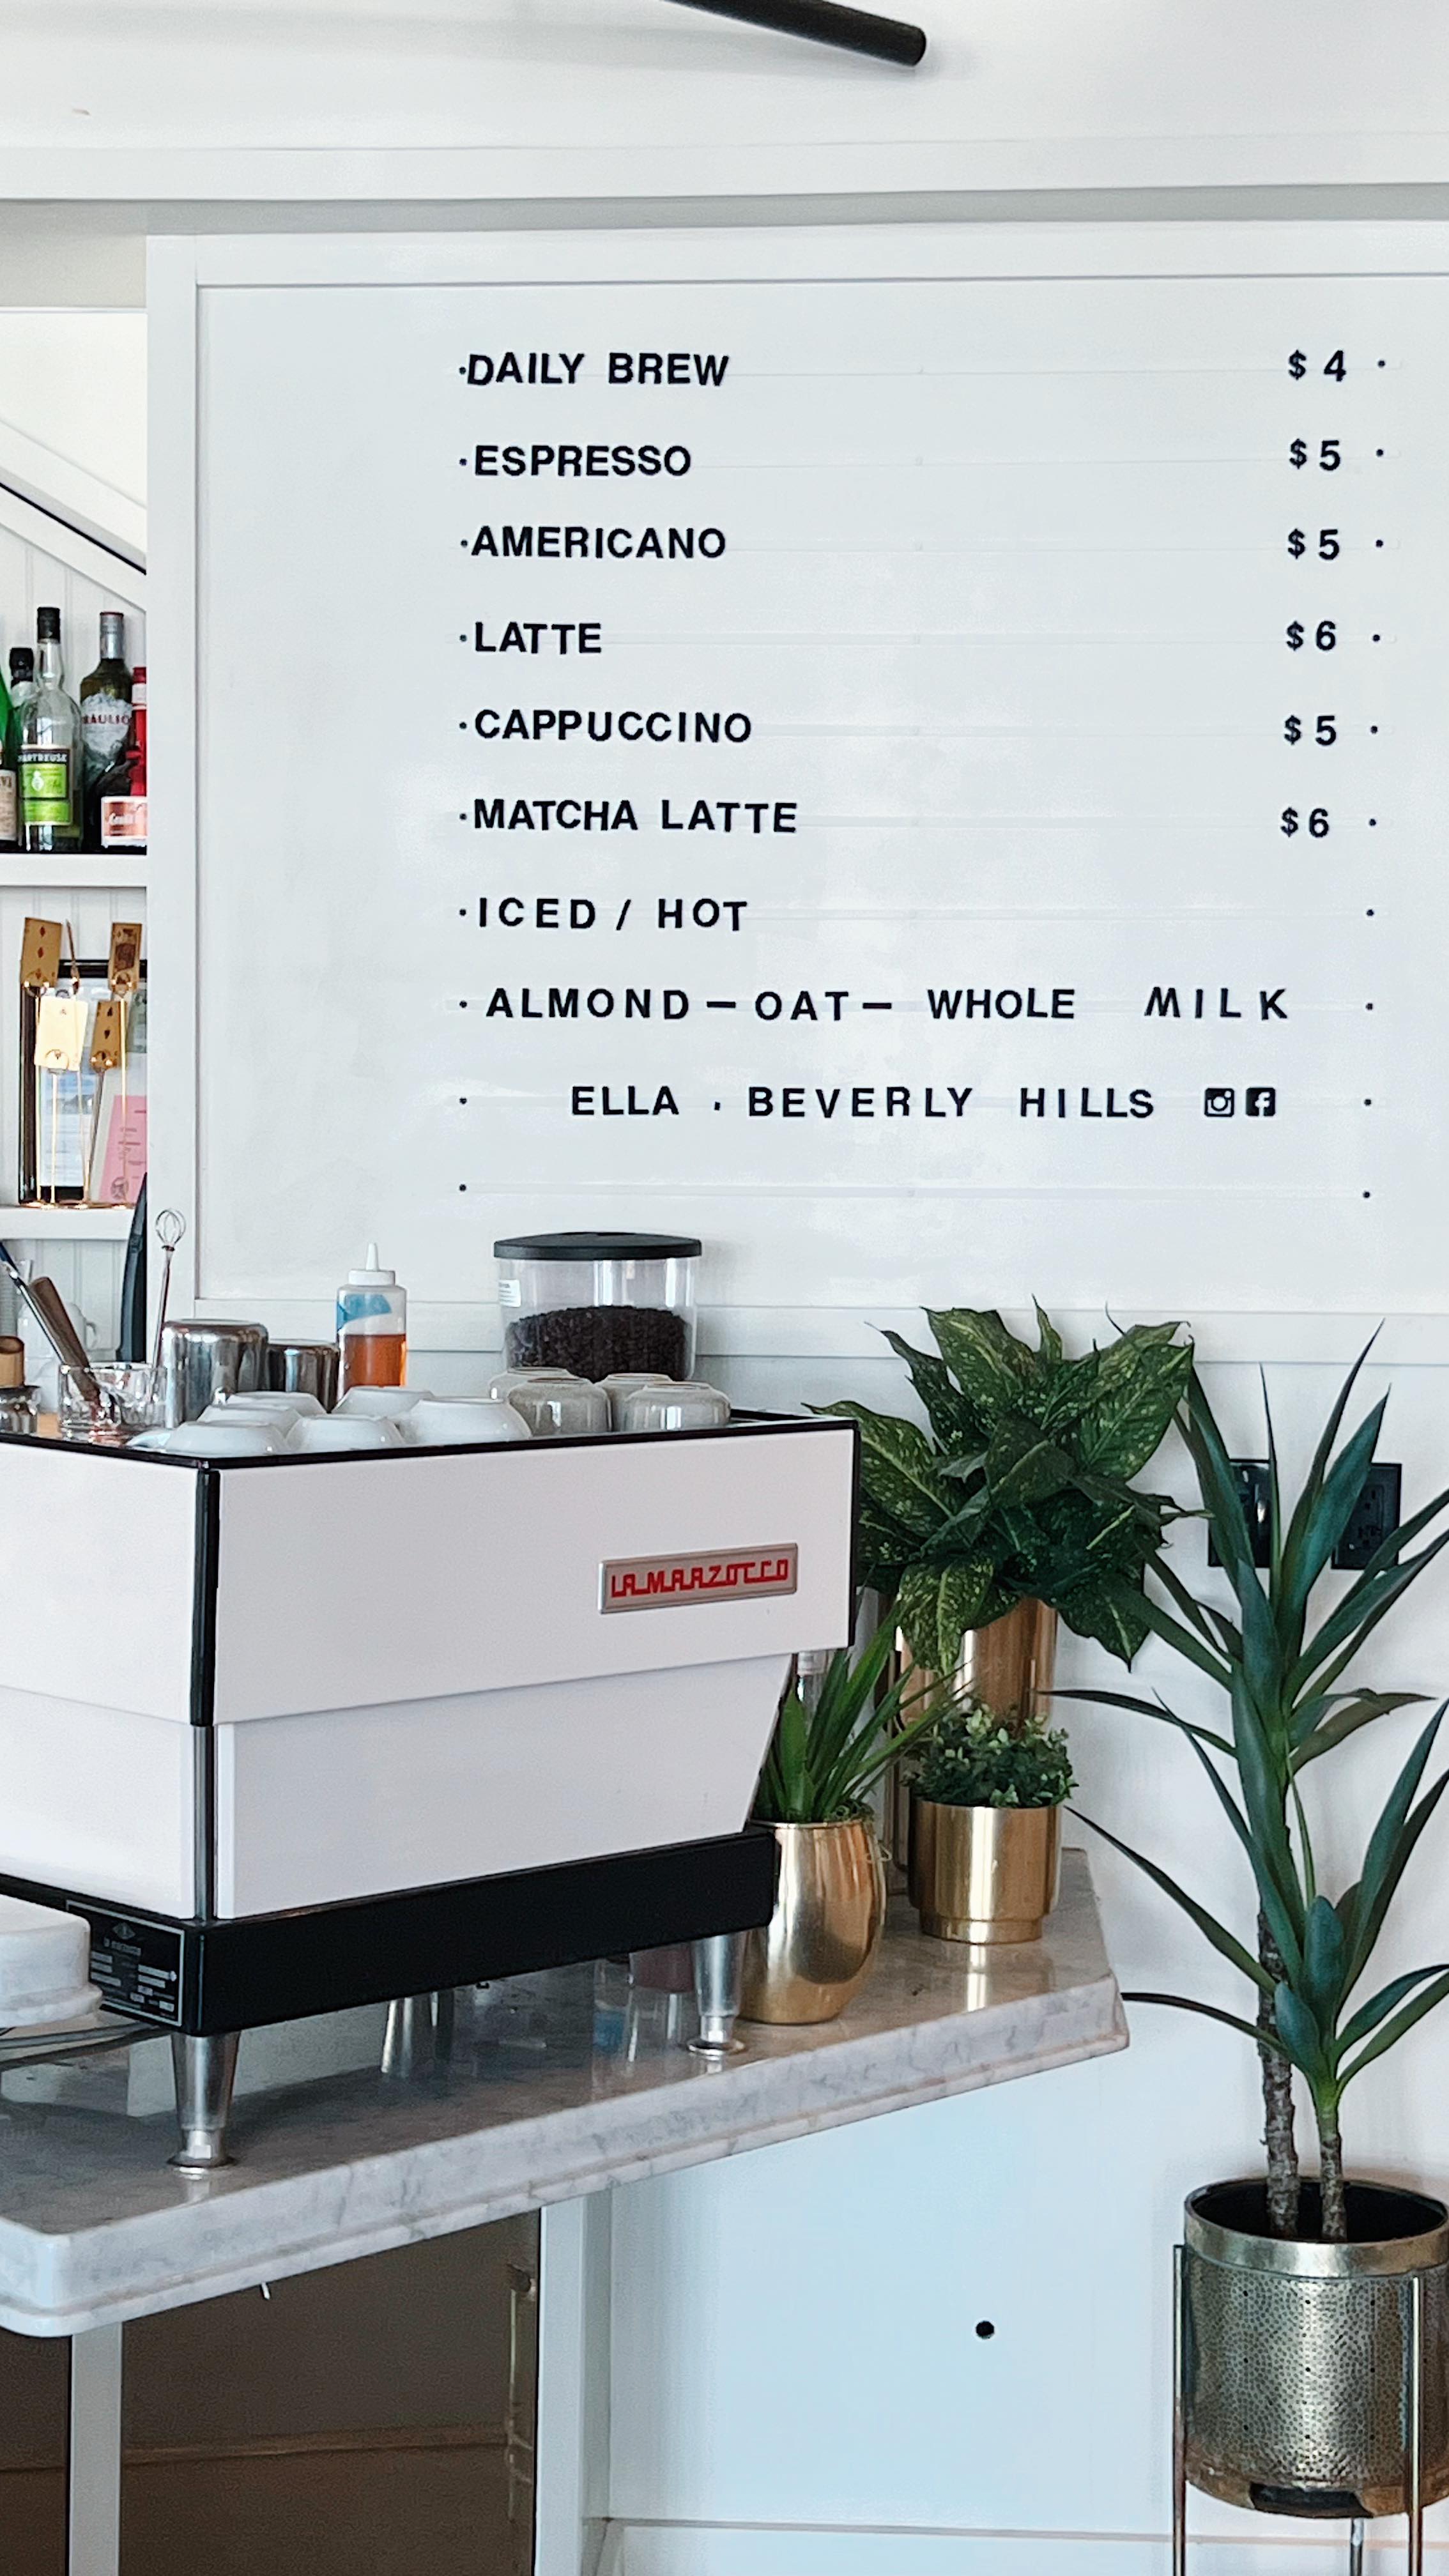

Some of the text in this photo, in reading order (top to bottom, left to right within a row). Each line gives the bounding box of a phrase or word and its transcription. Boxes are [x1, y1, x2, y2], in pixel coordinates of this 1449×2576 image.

[467, 351, 730, 387] DAILY BREW
[474, 444, 692, 477] ESPRESSO
[1289, 438, 1342, 472] $5
[470, 525, 726, 560] AMERICANO
[1287, 528, 1340, 561] $5
[474, 620, 602, 656] LATTE
[1285, 620, 1337, 652] $6
[82, 713, 130, 725] RAULIO
[474, 709, 752, 744] CAPPUCCINO
[1284, 714, 1337, 747] $5
[473, 798, 798, 834] MATCHA LATTE
[1280, 806, 1330, 839] $6
[479, 896, 596, 930] ICED
[657, 898, 748, 932] HOT
[485, 987, 689, 1020] ALMOND
[926, 987, 1076, 1020] WHOLE
[1144, 986, 1288, 1021] MILK
[571, 1085, 1154, 1119] ELLA BEVERLY HILLS
